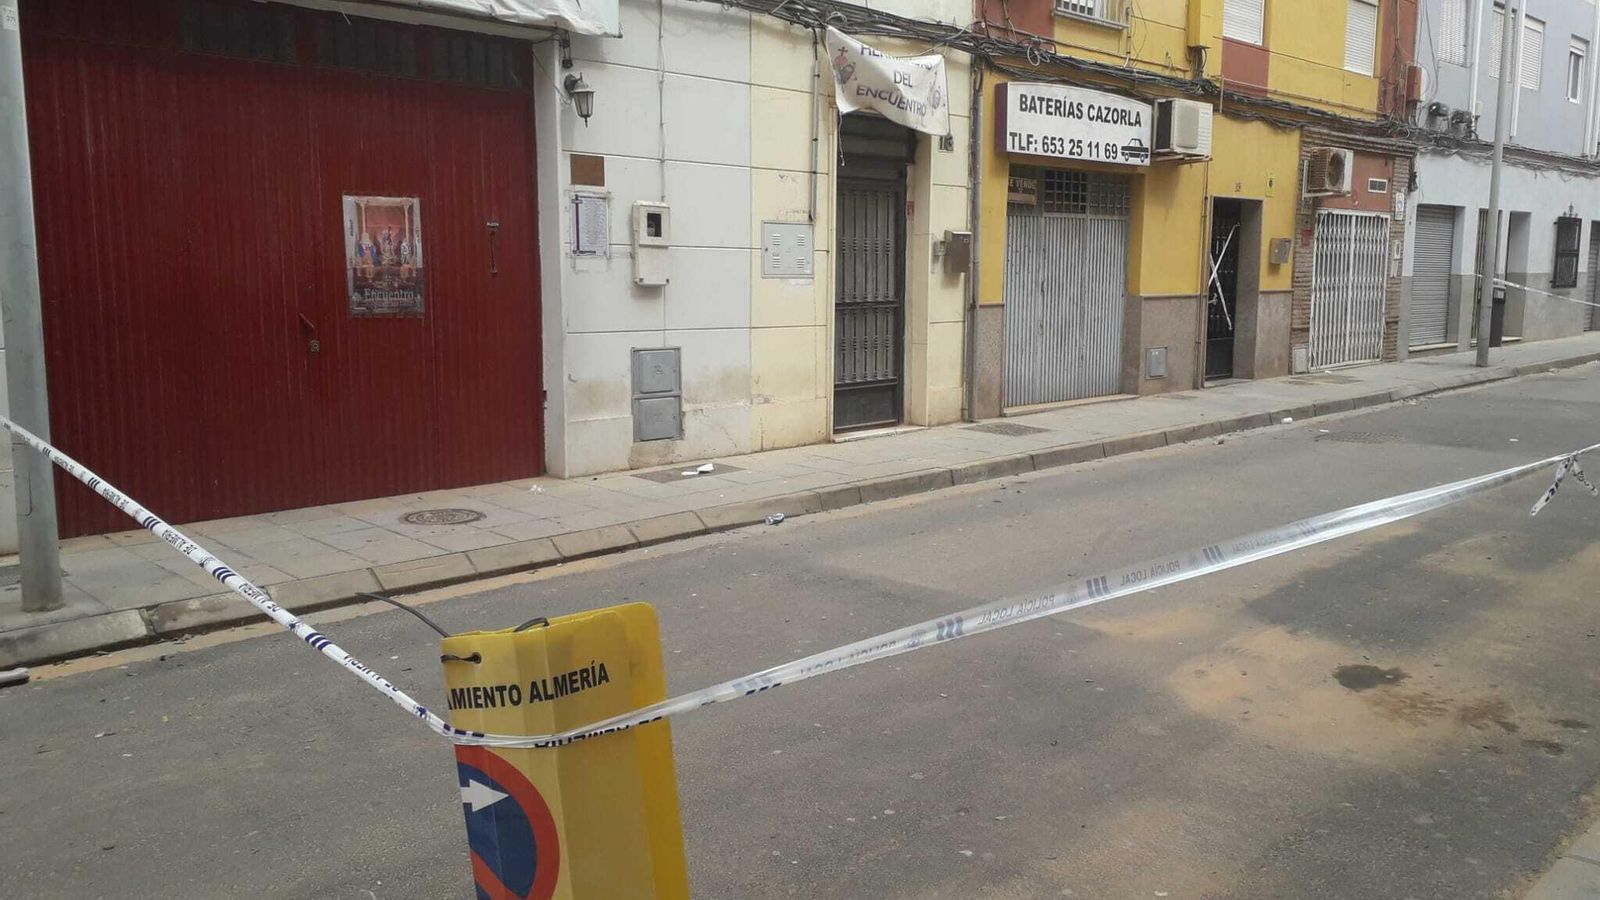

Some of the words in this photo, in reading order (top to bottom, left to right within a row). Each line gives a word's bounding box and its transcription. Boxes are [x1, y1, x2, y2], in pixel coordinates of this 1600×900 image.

[894, 71, 913, 88] DEL
[856, 84, 927, 117] ENCUENTRO
[1019, 93, 1084, 120] BATERÍAS
[1087, 104, 1142, 127] CAZORLA
[1009, 131, 1038, 152] TLF:
[1041, 135, 1064, 155] 653
[1068, 138, 1083, 157] 25
[1087, 140, 1099, 158] 11
[1104, 142, 1118, 160] 69
[528, 659, 610, 704] ALMERÍA
